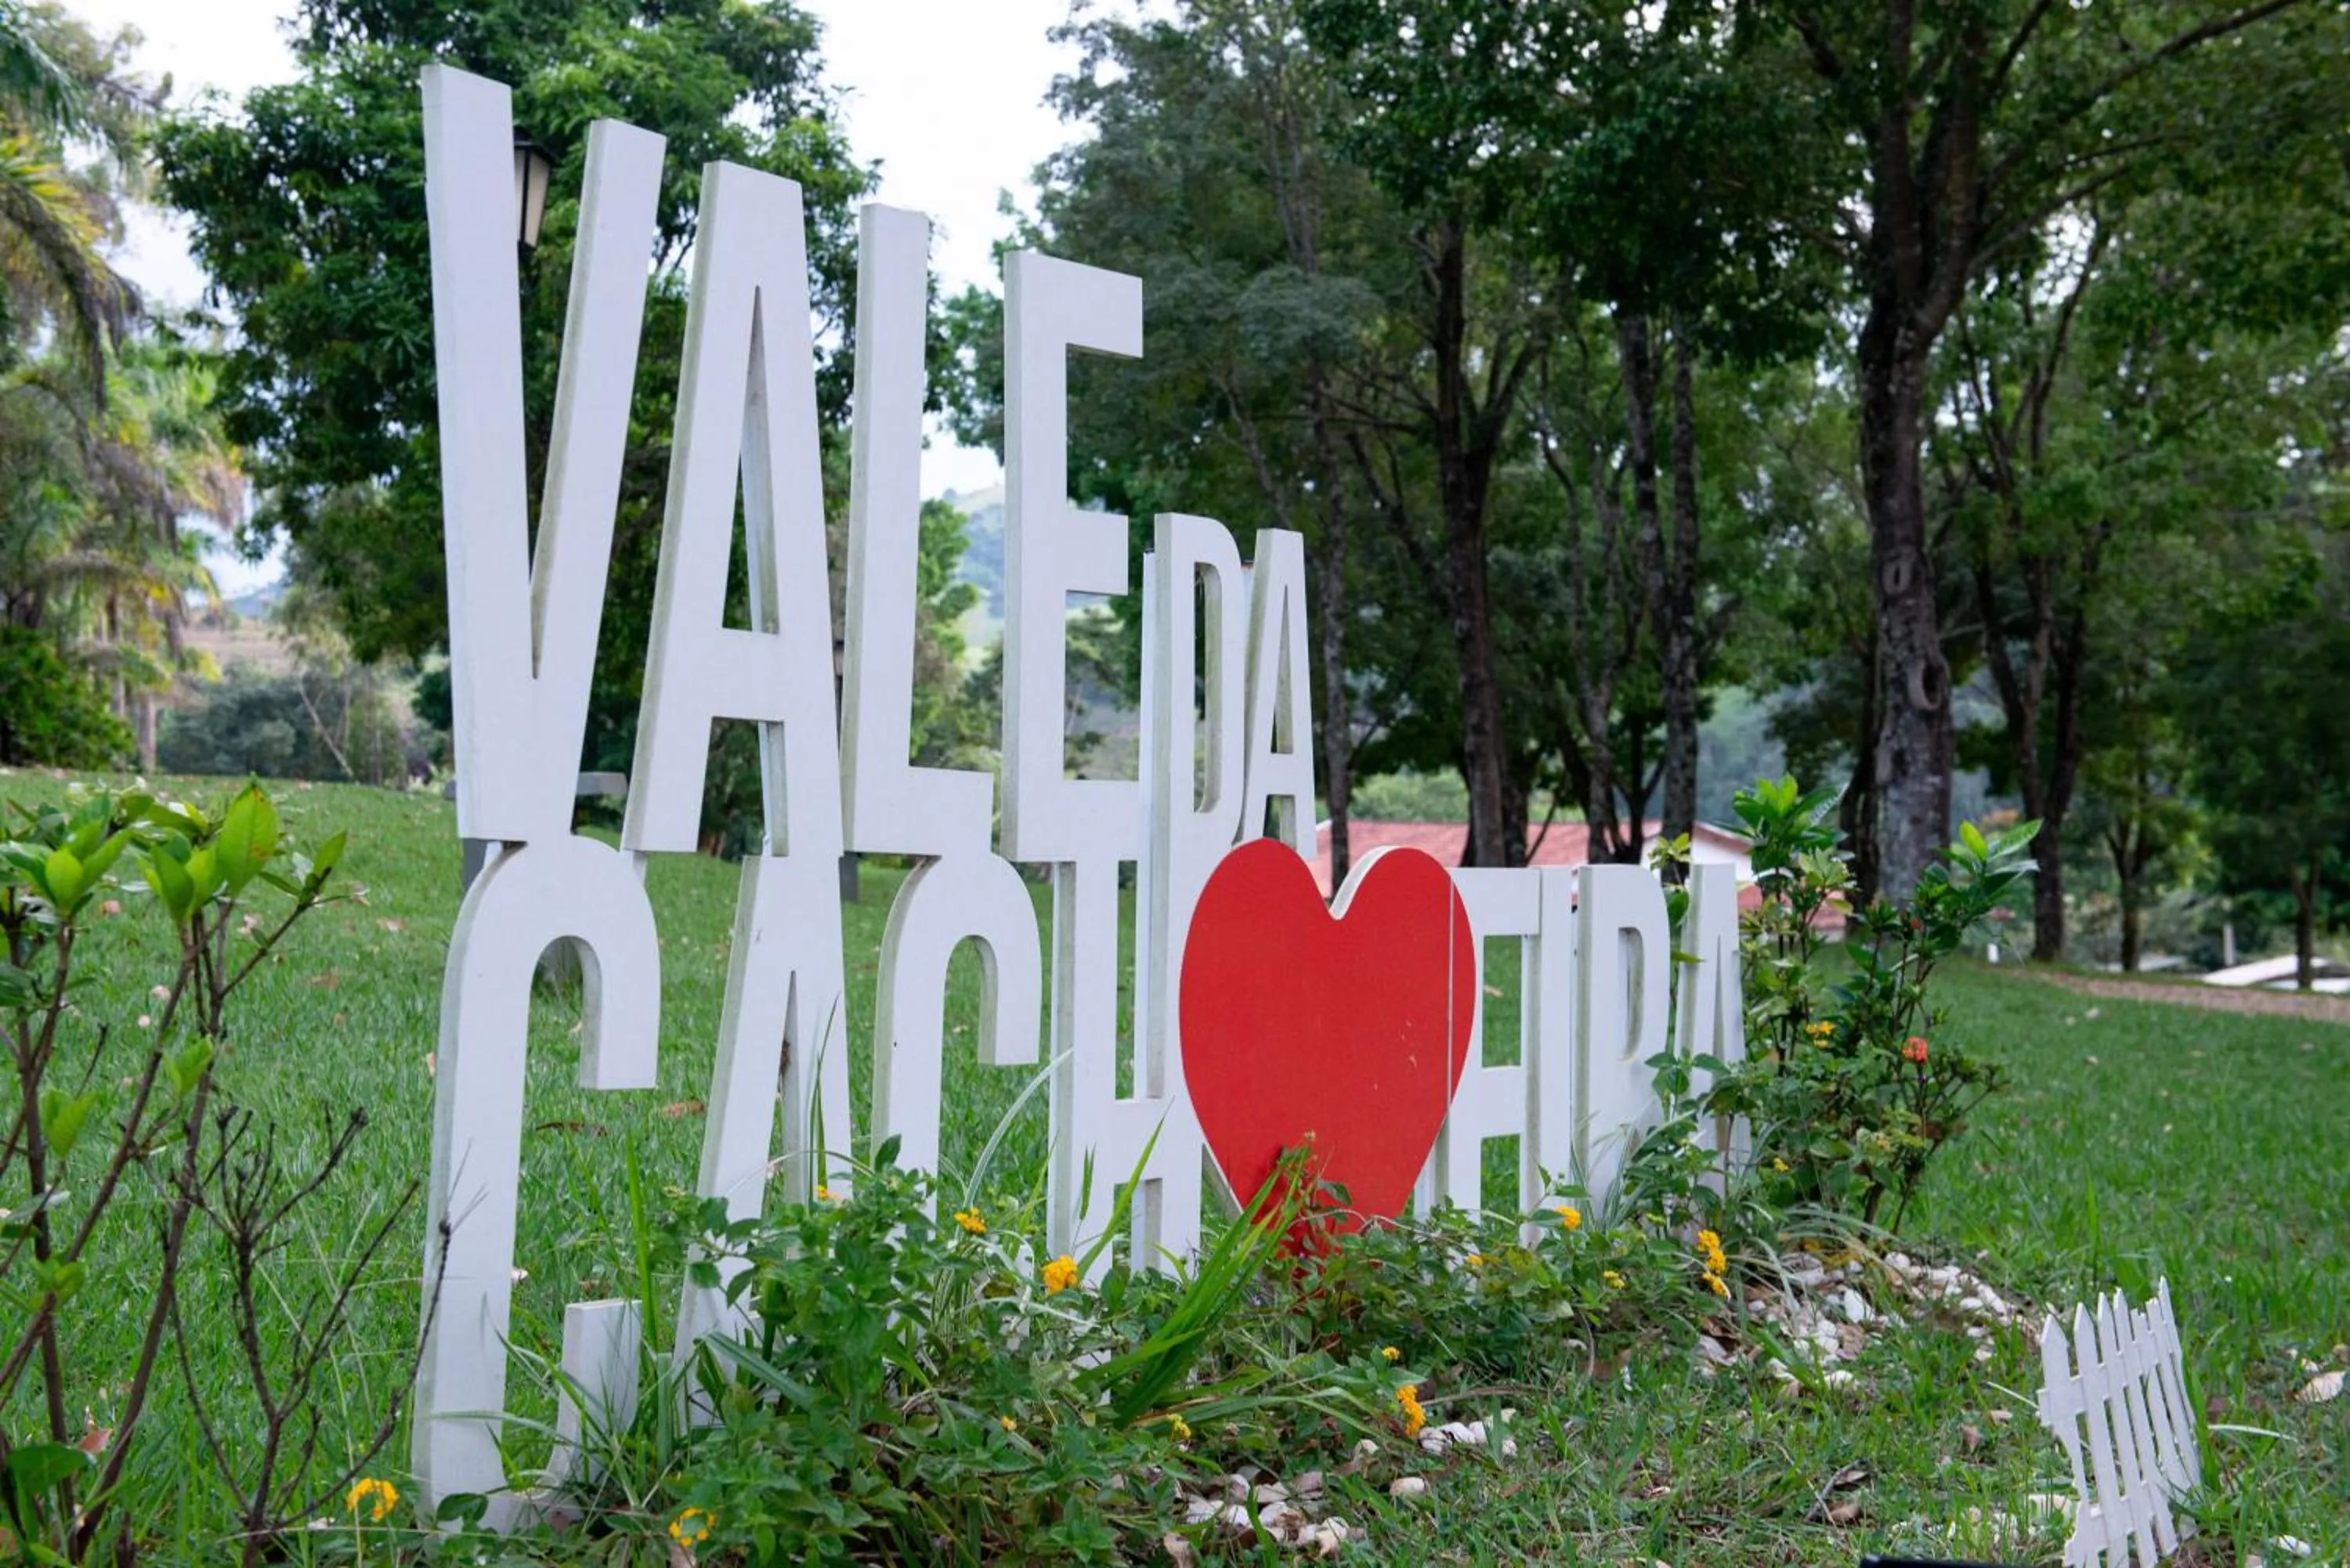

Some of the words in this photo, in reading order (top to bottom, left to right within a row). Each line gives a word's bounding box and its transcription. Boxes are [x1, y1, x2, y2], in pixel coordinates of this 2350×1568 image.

[421, 63, 1144, 863] VALE
[1153, 511, 1318, 864] DA
[411, 835, 1753, 1535] CACHEIRA
